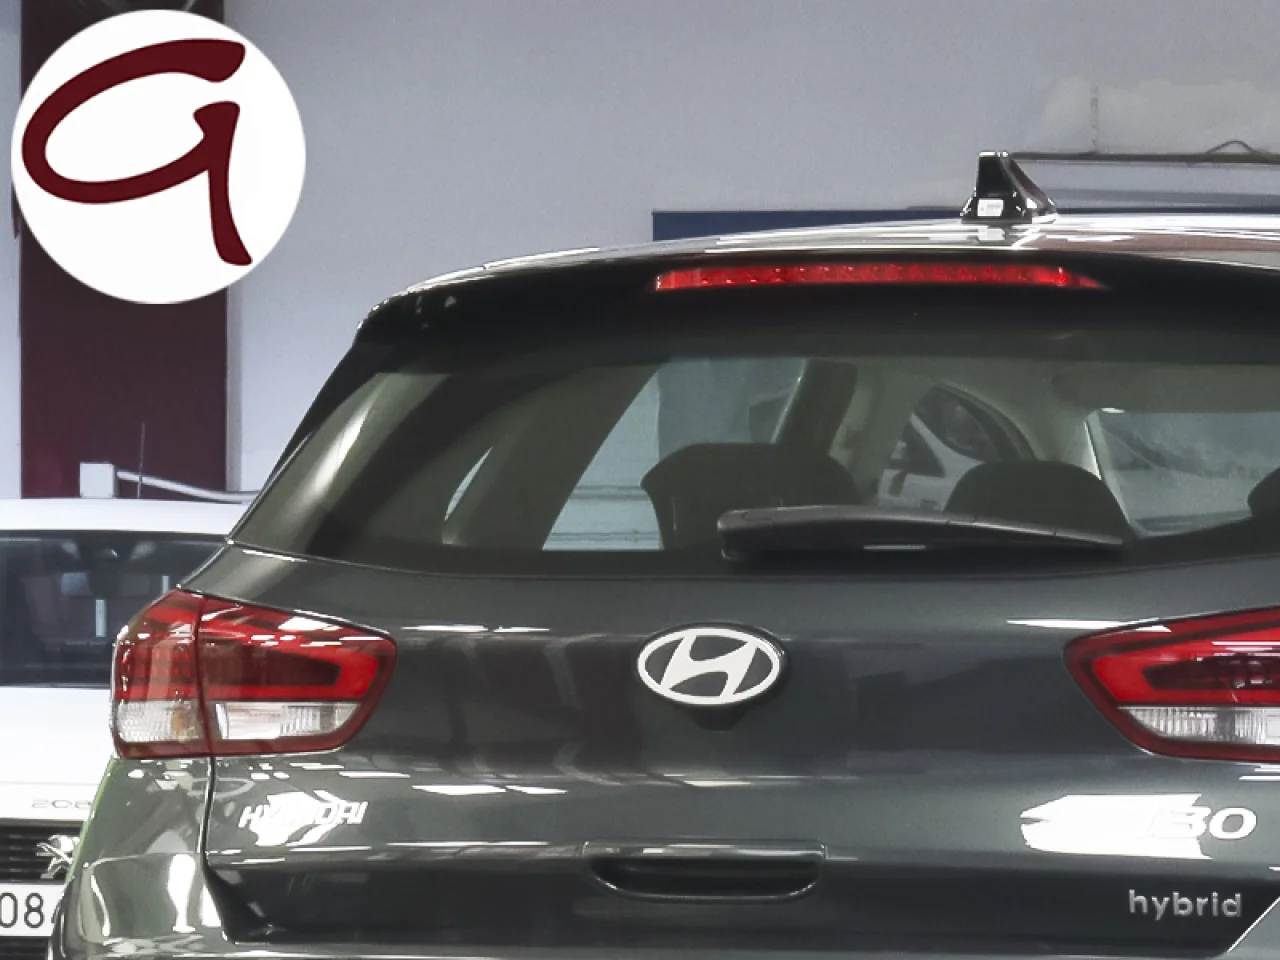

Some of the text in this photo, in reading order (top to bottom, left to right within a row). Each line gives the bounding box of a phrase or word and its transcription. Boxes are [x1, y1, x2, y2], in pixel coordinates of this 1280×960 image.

[238, 801, 369, 828] HYDAI
[0, 892, 59, 928] 08
[1128, 889, 1242, 921] hybrid
